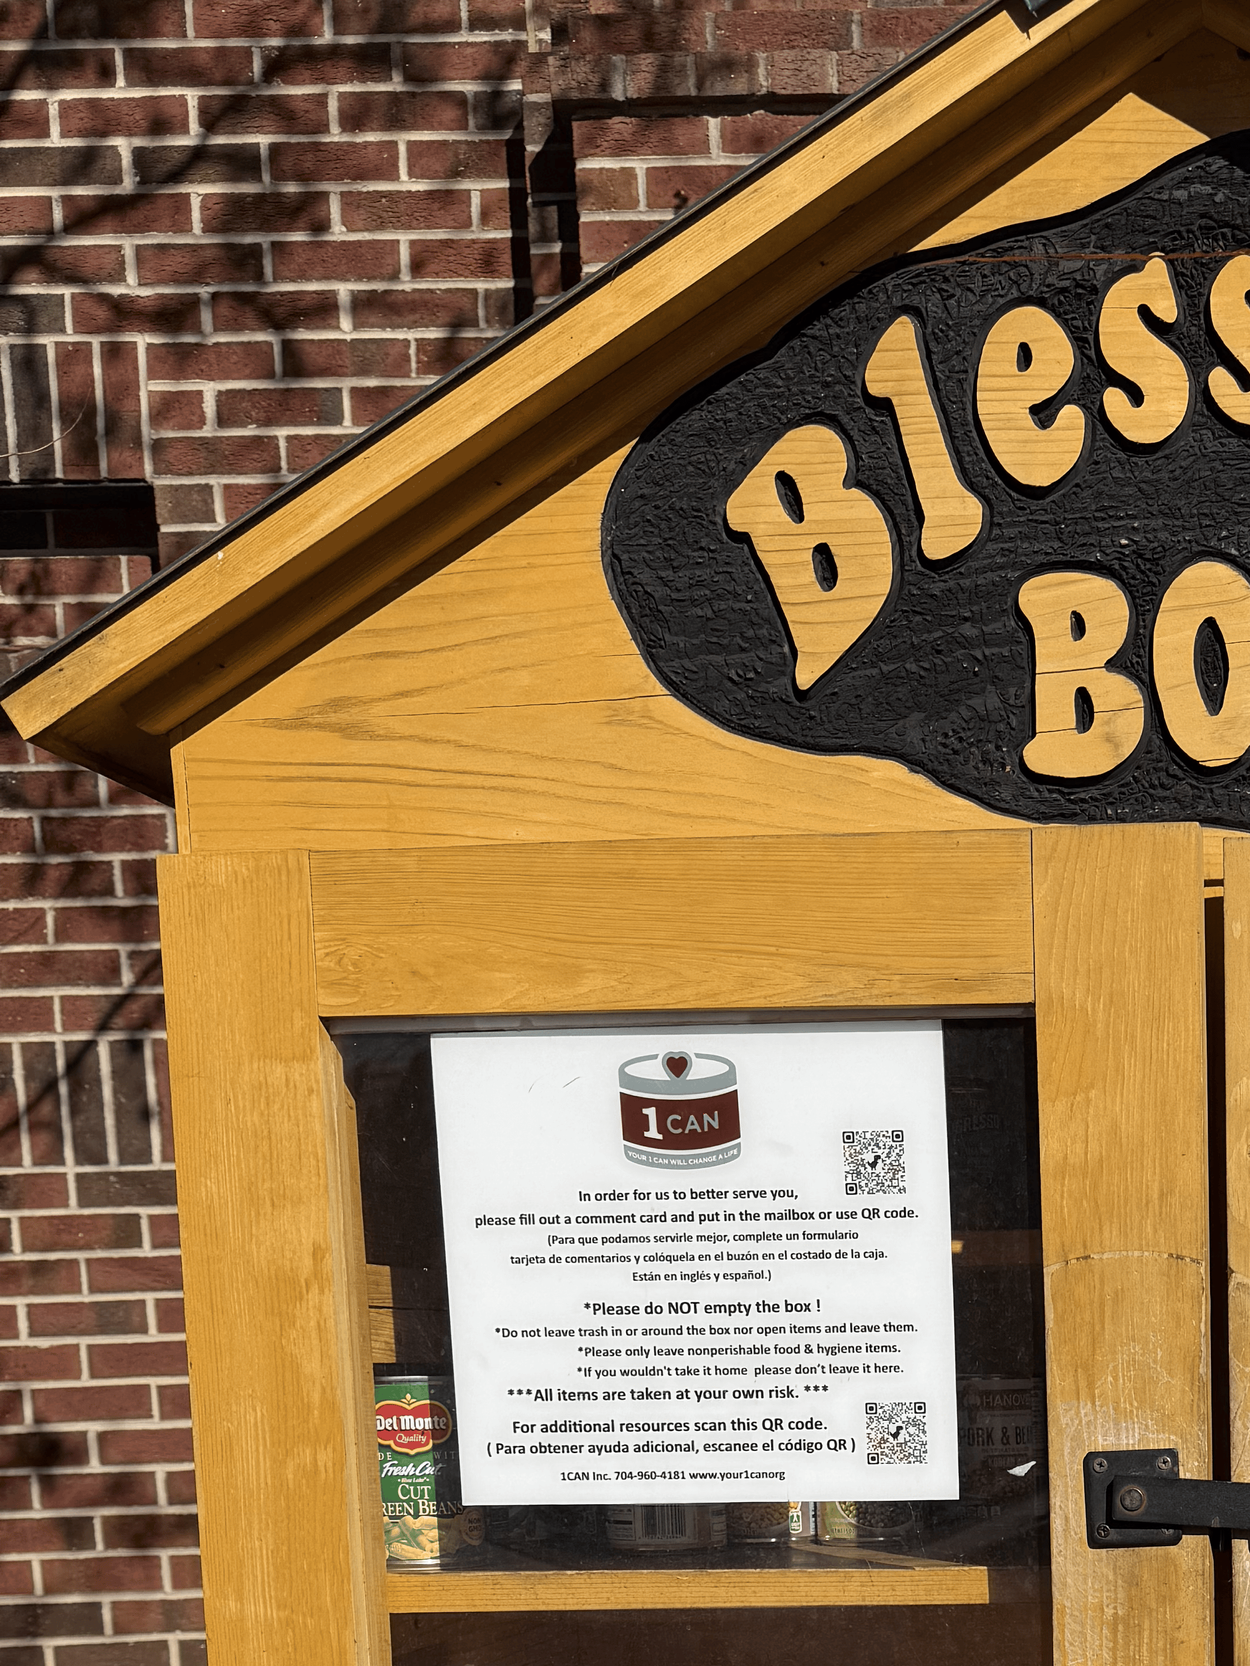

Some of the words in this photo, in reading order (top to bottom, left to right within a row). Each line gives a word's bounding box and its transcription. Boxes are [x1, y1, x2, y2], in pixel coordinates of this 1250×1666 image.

[642, 1107, 663, 1140] 1
[667, 1111, 719, 1134] CAN
[628, 1150, 647, 1161] YOUR
[689, 1155, 717, 1165] CHANGE
[724, 1148, 738, 1158] LIFE
[578, 1190, 591, 1202] In
[594, 1189, 630, 1202] order
[632, 1188, 652, 1201] for
[655, 1191, 670, 1201] us
[672, 1189, 687, 1201] to
[689, 1187, 730, 1200] better
[732, 1189, 768, 1200] serve
[770, 1189, 799, 1202] you,
[475, 1214, 516, 1229] please
[518, 1213, 536, 1226] fill
[538, 1214, 561, 1225] out
[564, 1215, 572, 1225] a
[575, 1213, 637, 1225] comment
[639, 1210, 668, 1224] card
[670, 1210, 695, 1223] and
[698, 1211, 721, 1225] put
[723, 1212, 736, 1222] in
[738, 1209, 761, 1222] the
[764, 1208, 816, 1222] mailbox
[818, 1211, 833, 1220] or
[835, 1210, 858, 1220] use
[861, 1207, 881, 1221] QR
[883, 1206, 919, 1219] code.
[644, 1301, 664, 1315] do
[667, 1301, 700, 1315] NOT
[703, 1301, 752, 1317] empty
[754, 1299, 781, 1314] the
[784, 1299, 812, 1313] box
[556, 1388, 599, 1402] items
[602, 1390, 627, 1401] are
[629, 1386, 672, 1401] taken
[675, 1388, 691, 1400] at
[693, 1389, 729, 1403] your
[732, 1389, 765, 1400] own
[768, 1385, 799, 1399] risk.
[376, 1415, 398, 1430] Del
[399, 1415, 447, 1430] Monte
[512, 1421, 537, 1434] For
[540, 1419, 615, 1434] additional
[619, 1421, 691, 1433] resources
[693, 1421, 727, 1432] scan
[730, 1417, 758, 1432] this
[761, 1417, 784, 1433] QR
[787, 1416, 828, 1431] code.
[396, 1433, 427, 1444] Quality
[382, 1461, 415, 1478] Fresh
[415, 1460, 447, 1476] Cut
[560, 1471, 590, 1481] 1CAN
[592, 1471, 614, 1481] Inc.
[613, 1470, 686, 1481] 704-960-4181
[688, 1469, 786, 1482] www.your1canorg
[398, 1484, 431, 1499] CUT
[382, 1502, 414, 1516] REEN
